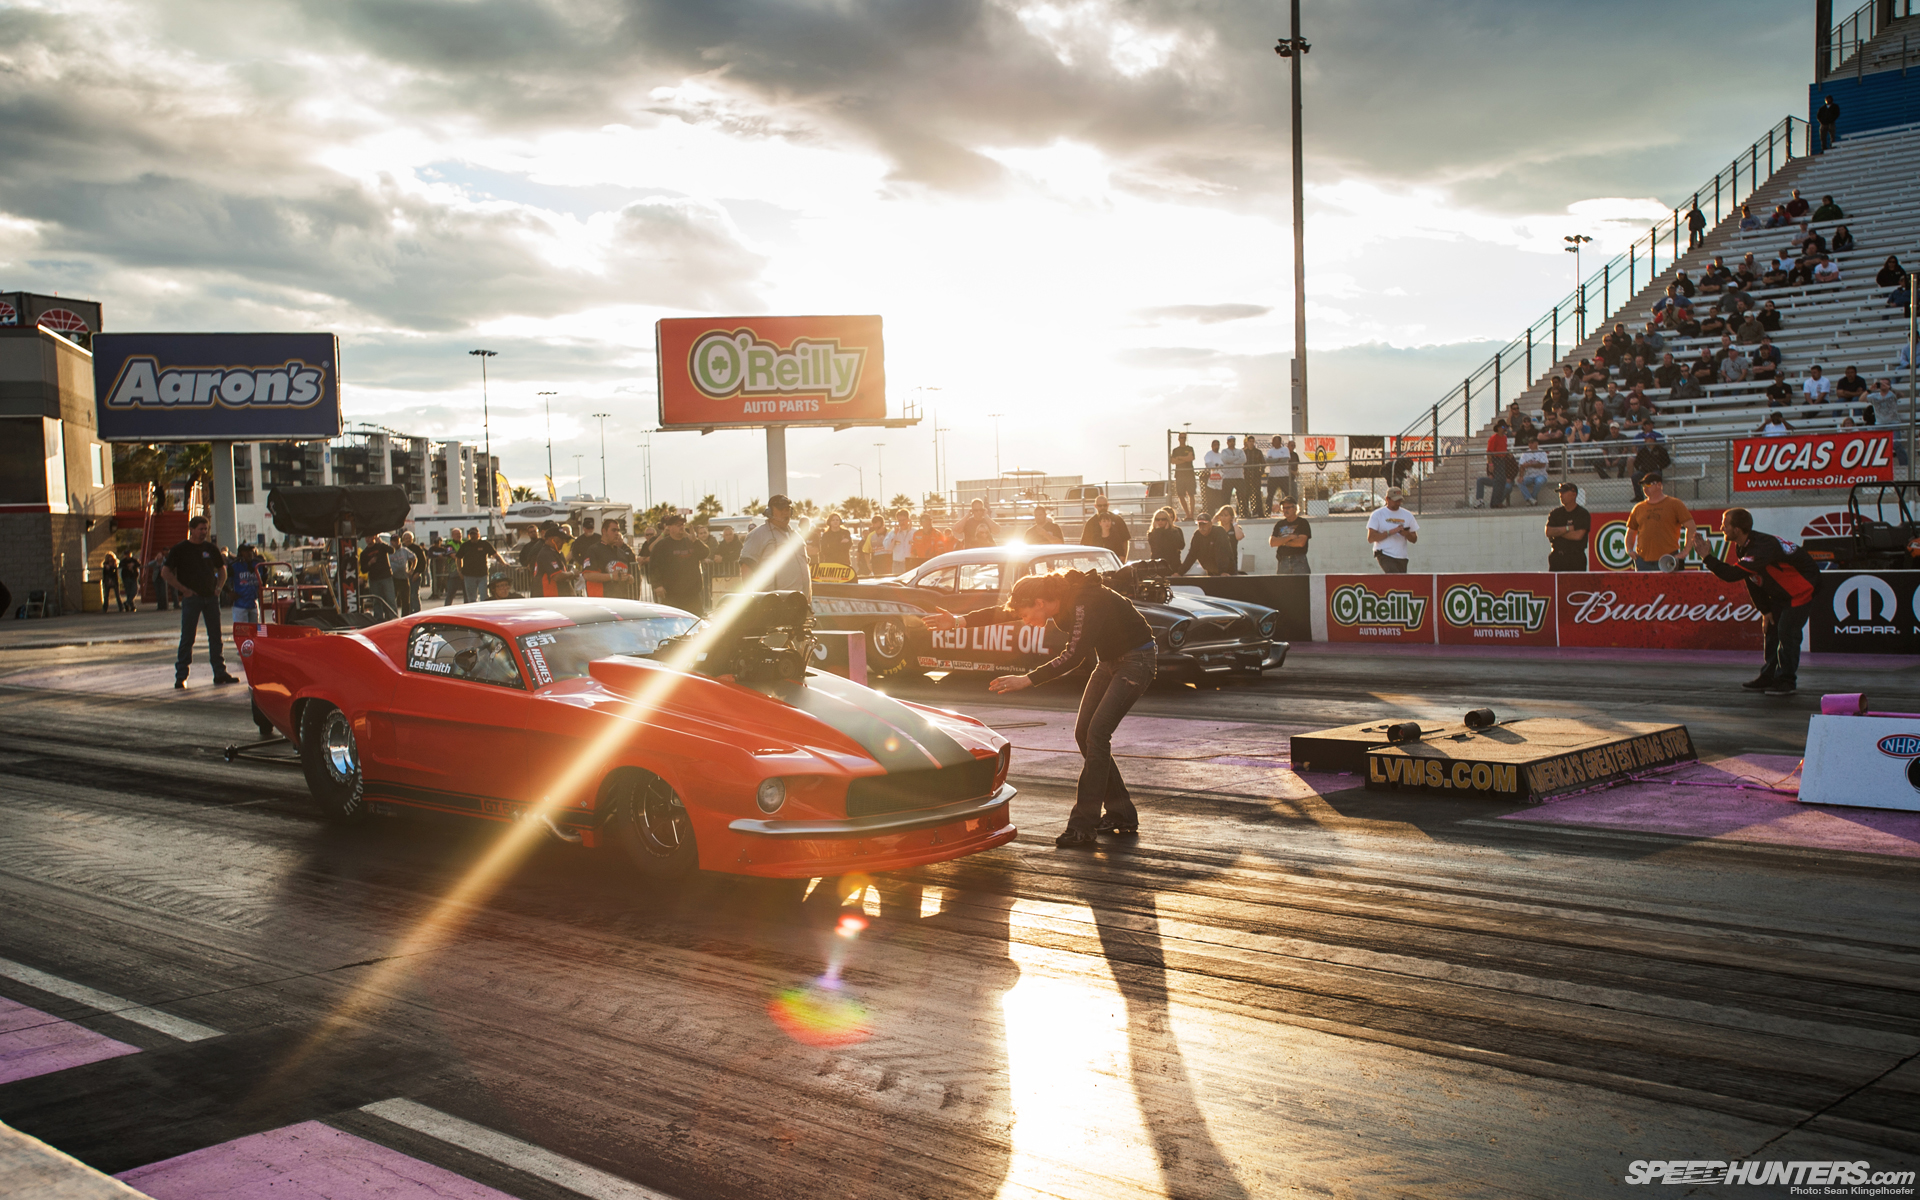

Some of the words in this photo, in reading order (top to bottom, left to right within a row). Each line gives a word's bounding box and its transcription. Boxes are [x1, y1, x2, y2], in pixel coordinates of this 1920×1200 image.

[696, 336, 857, 394] O'Reilly
[112, 361, 320, 404] Aaron's
[743, 401, 776, 414] AUTO
[779, 400, 819, 412] PARTS
[1351, 447, 1383, 460] ROSS
[1737, 441, 1835, 473] LUCAS
[1841, 438, 1889, 469] OIL
[1746, 475, 1878, 488] www.LucasOil.com
[811, 563, 852, 578] UNLIMITED
[1335, 589, 1422, 625] O'Reilly
[1447, 589, 1543, 627] O'Reilly
[932, 626, 967, 650] RED
[973, 625, 1013, 652] LINE
[1018, 625, 1050, 655] OIL
[1359, 628, 1377, 636] AUTO
[1378, 628, 1401, 636] PARTS
[1474, 629, 1494, 638] AUTO
[1495, 629, 1520, 638] PARTS
[414, 641, 439, 659] 631
[409, 657, 425, 670] Lee
[425, 660, 451, 674] Smith
[531, 648, 553, 684] HUGHES
[1369, 756, 1517, 793] LVMS.COM
[1526, 754, 1586, 793] AMERICA'S
[1582, 741, 1637, 779] GREATEST
[1633, 734, 1665, 765] DRAG
[1660, 728, 1689, 758] STRIP
